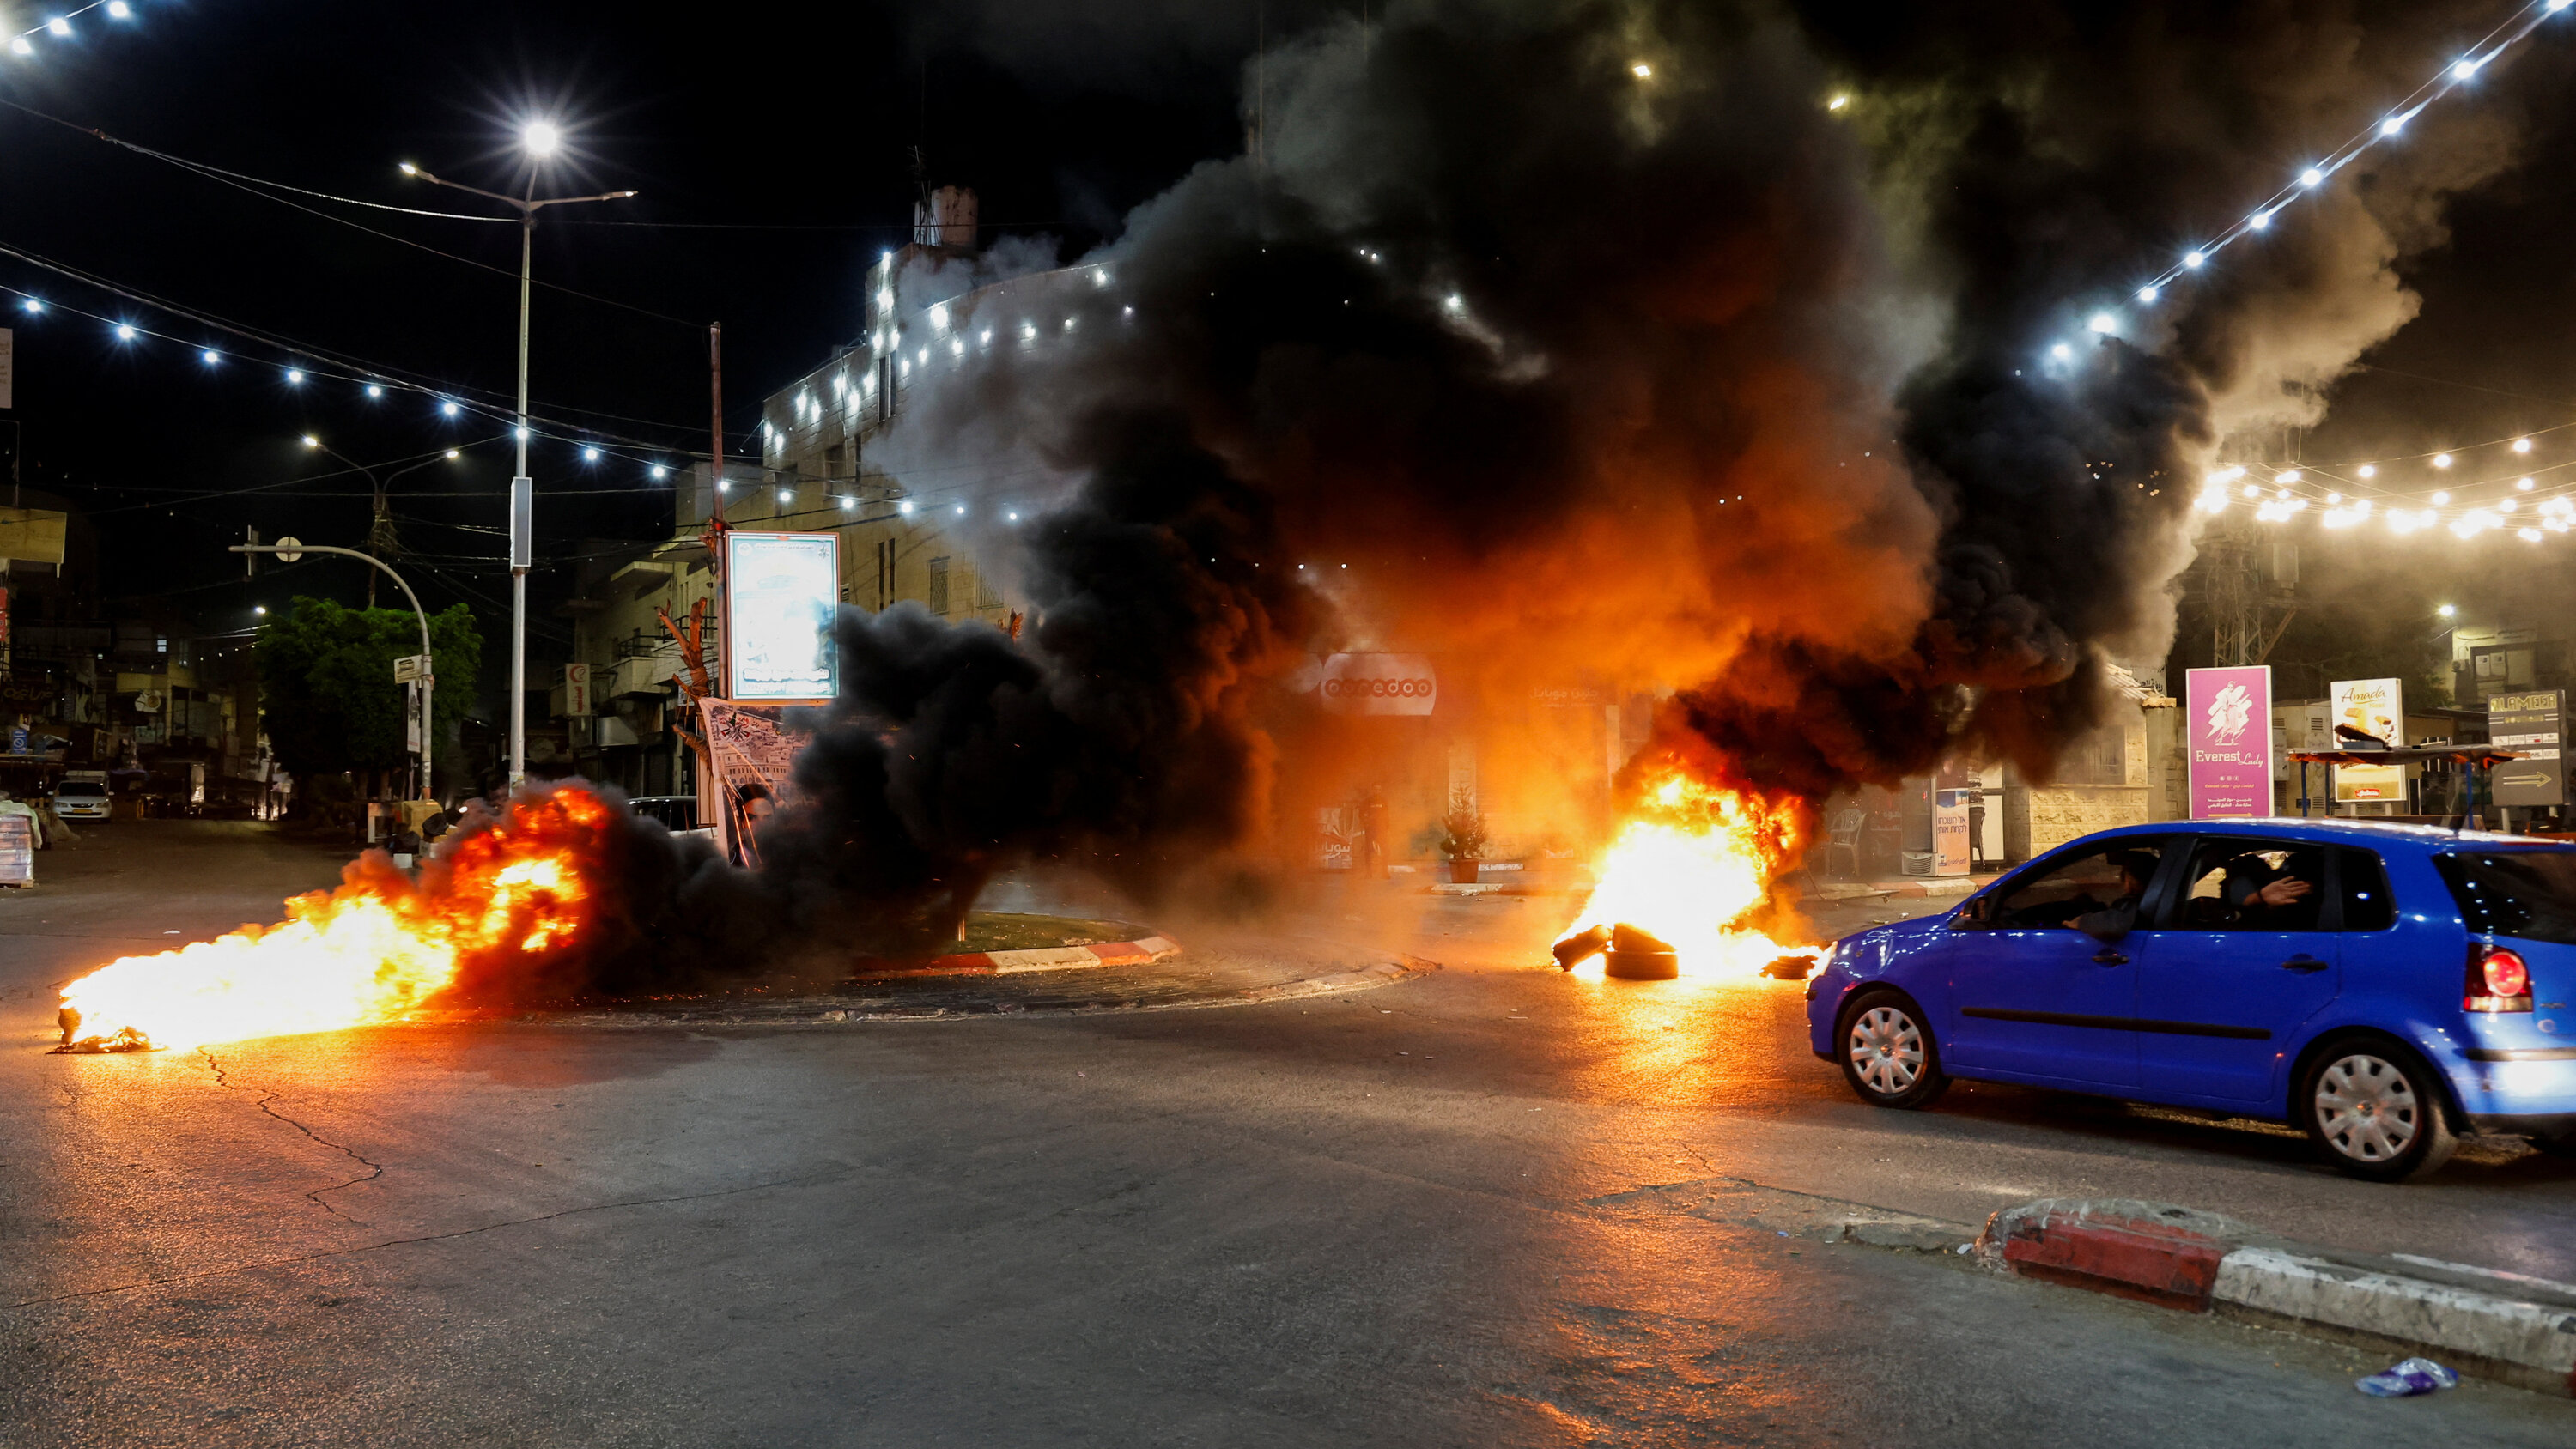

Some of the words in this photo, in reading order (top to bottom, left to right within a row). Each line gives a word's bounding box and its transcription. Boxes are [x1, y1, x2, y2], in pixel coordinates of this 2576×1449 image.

[2342, 686, 2385, 702] Amada
[2196, 749, 2241, 762] Everest
[2238, 752, 2263, 768] Lady
